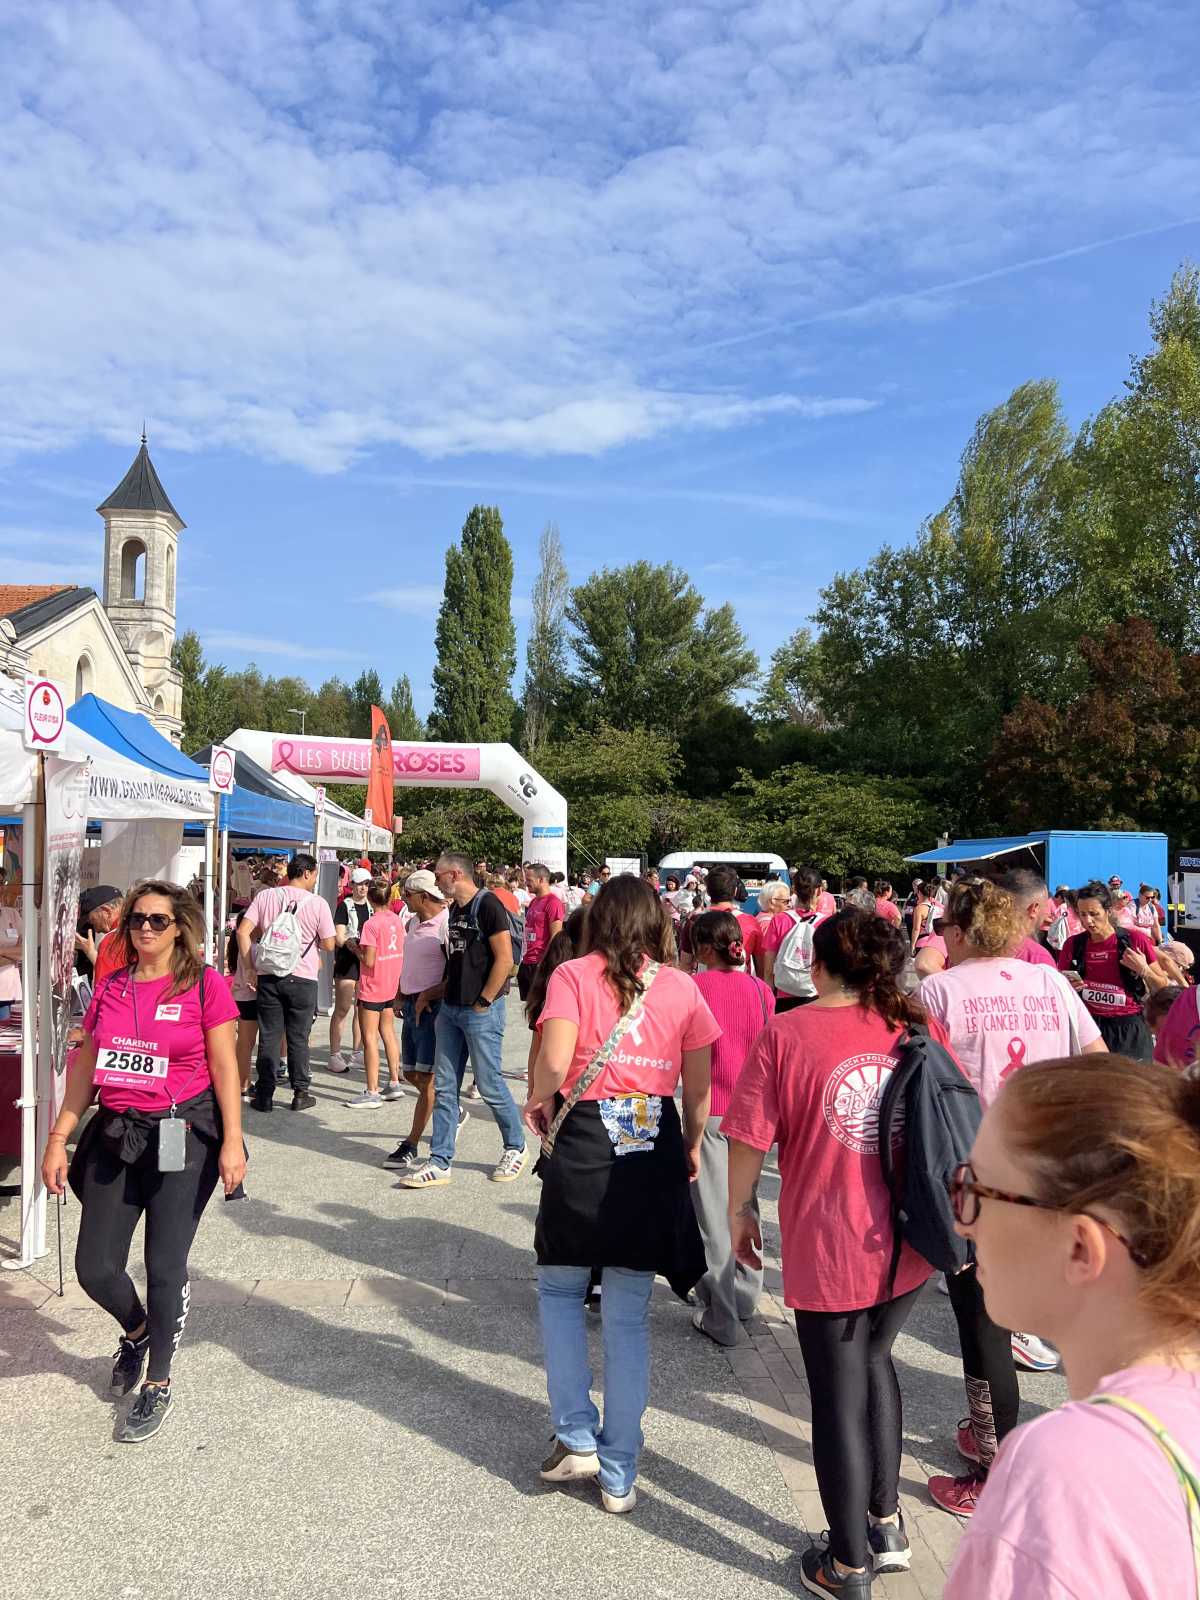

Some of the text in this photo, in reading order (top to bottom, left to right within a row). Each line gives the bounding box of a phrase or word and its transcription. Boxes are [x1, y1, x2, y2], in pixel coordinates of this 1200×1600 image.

[299, 748, 322, 769] LES
[331, 749, 372, 770] BULL
[392, 752, 466, 773] ROSES
[962, 995, 1058, 1014] ENSEMBLE CONTE
[1088, 991, 1115, 1004] 2040
[966, 1016, 978, 1034] LE
[984, 1014, 1019, 1031] CANCER
[1024, 1013, 1037, 1031] DU
[111, 1036, 159, 1051] CHARENTE
[104, 1051, 154, 1074] 2588
[609, 1049, 673, 1070] obrerose
